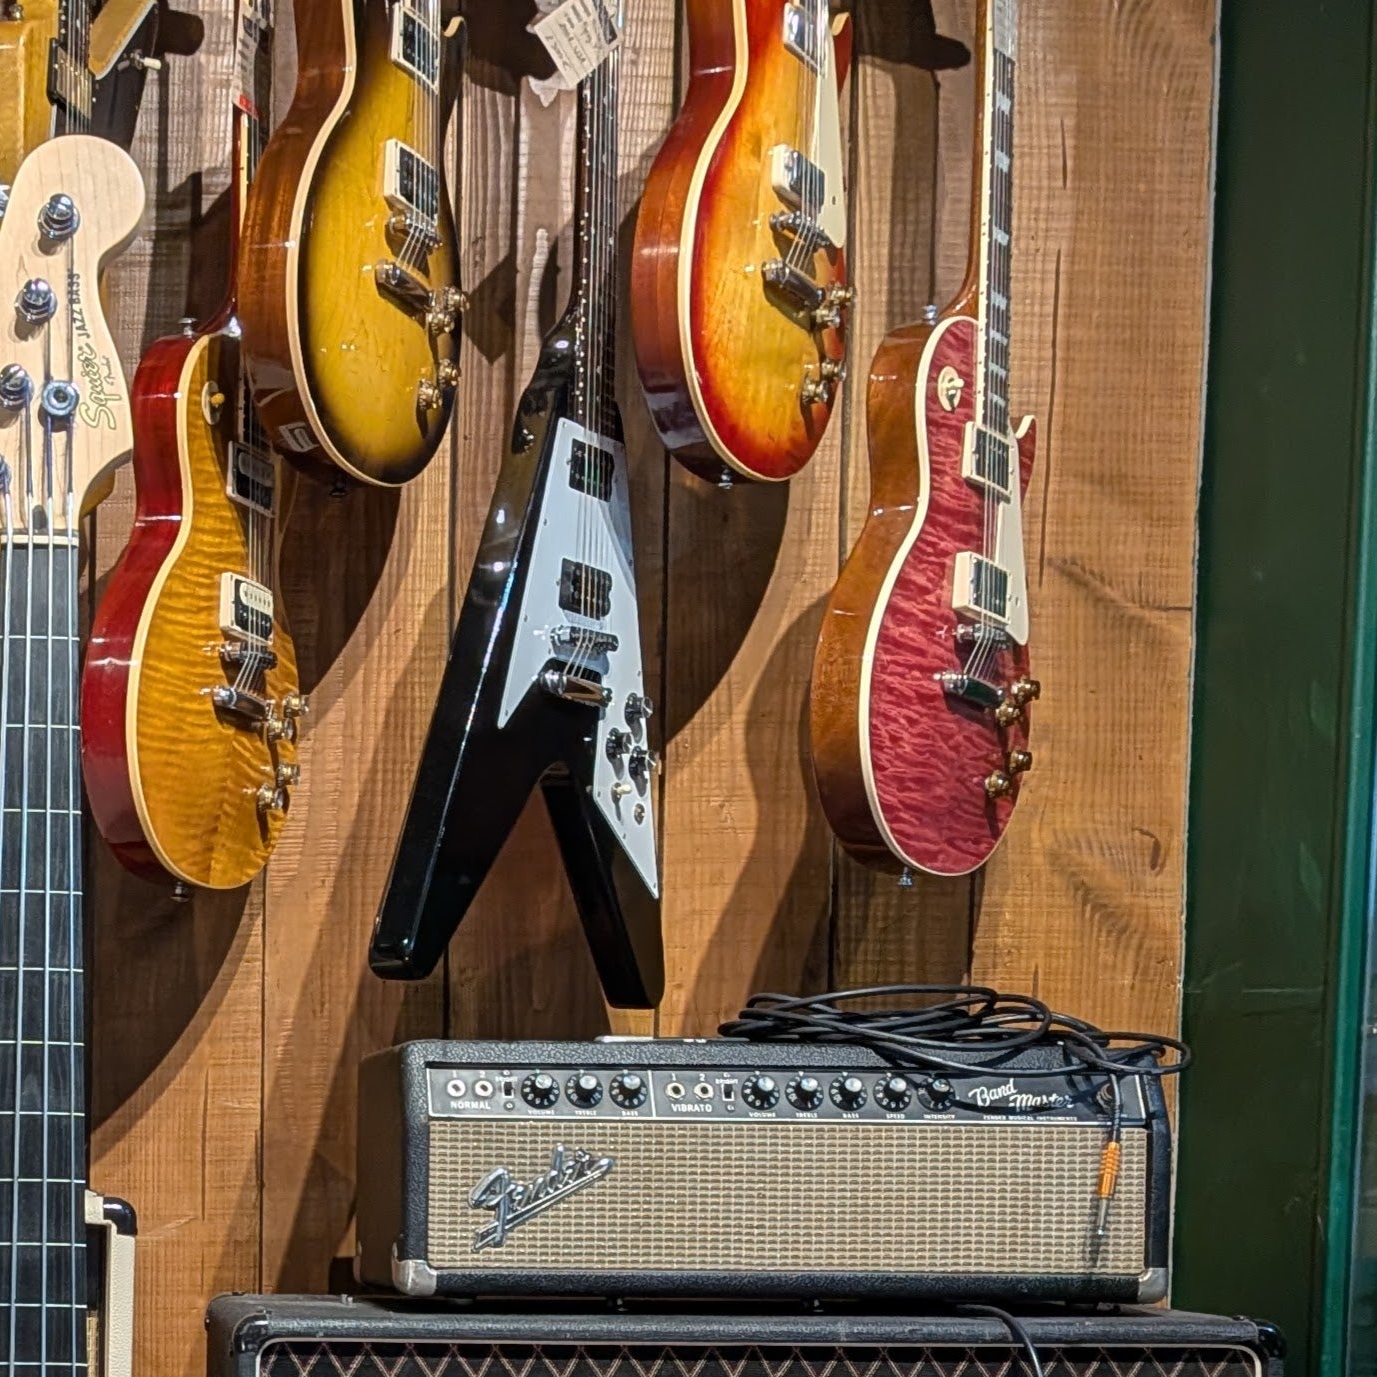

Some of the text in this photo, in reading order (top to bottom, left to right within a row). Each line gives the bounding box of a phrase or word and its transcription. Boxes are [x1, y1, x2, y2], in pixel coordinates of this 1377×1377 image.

[68, 272, 123, 430] Squier JAZZ BASS
[968, 1078, 1018, 1107] Band
[1008, 1093, 1075, 1112] Master
[450, 1100, 491, 1110] NORMAL
[671, 1103, 713, 1112] VIBRATO
[469, 1143, 615, 1250] Fender
